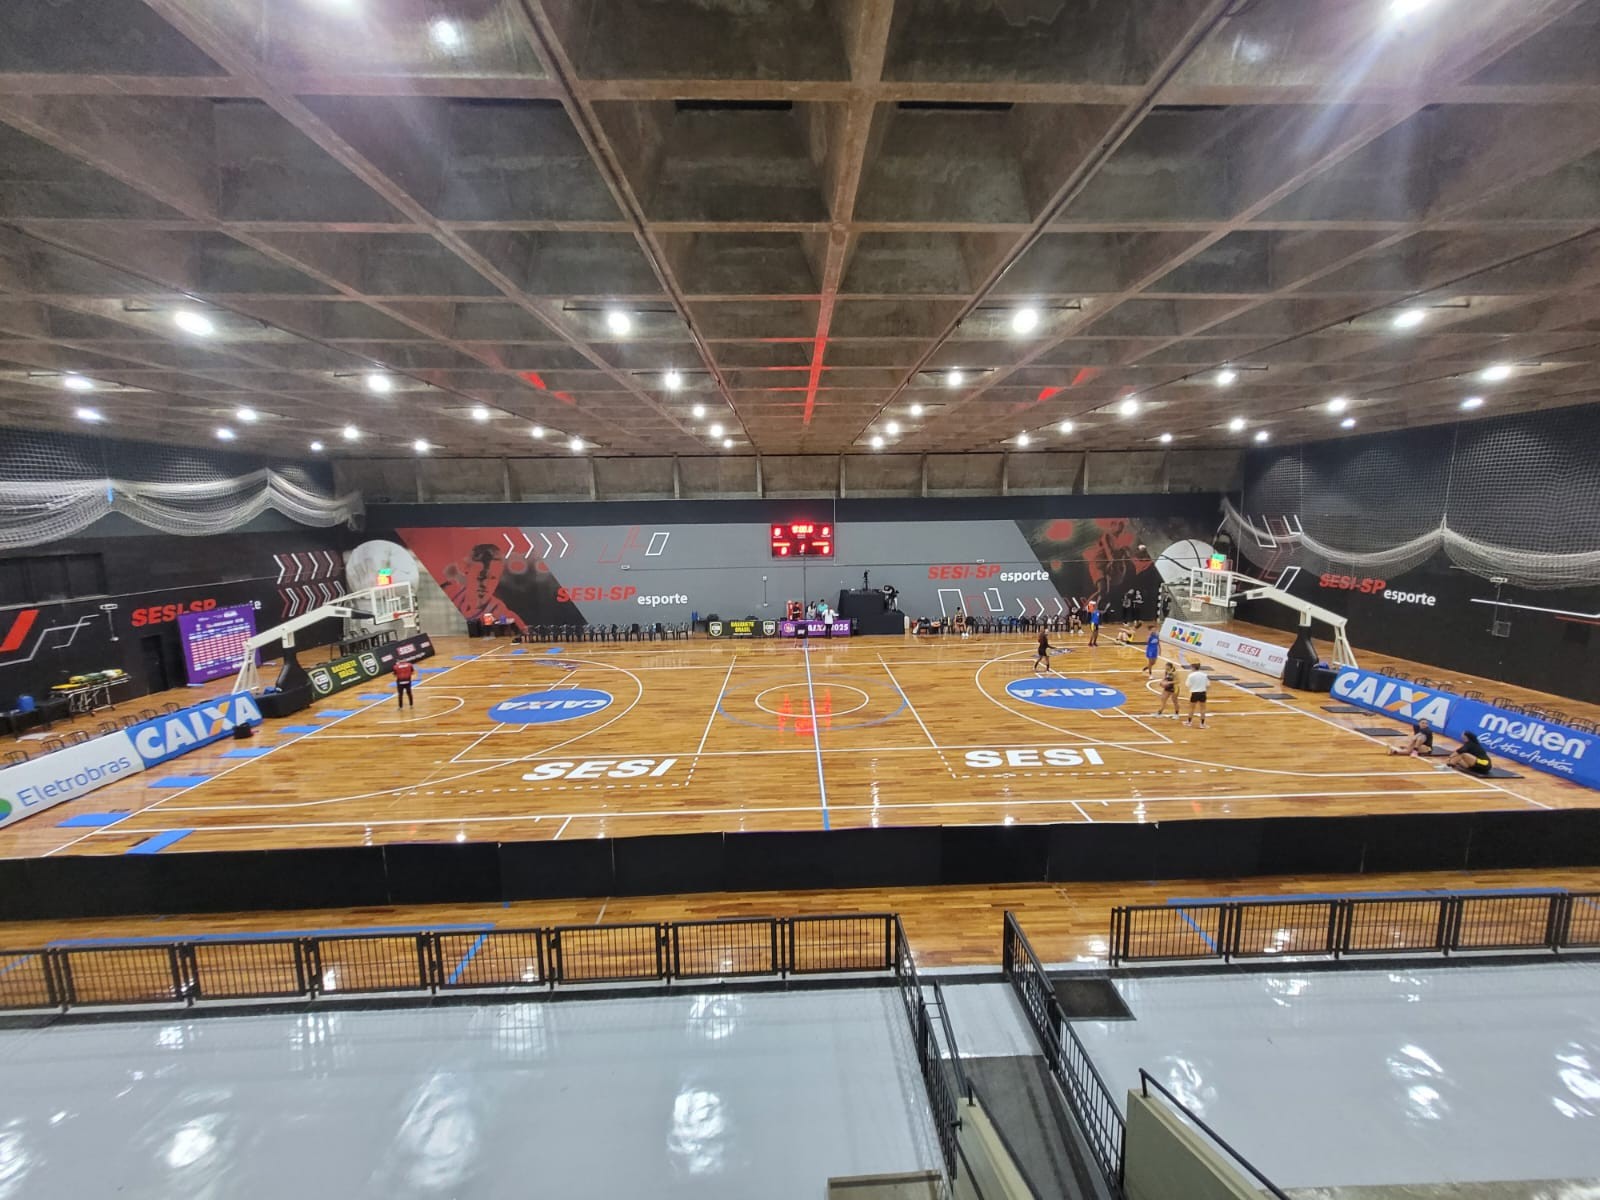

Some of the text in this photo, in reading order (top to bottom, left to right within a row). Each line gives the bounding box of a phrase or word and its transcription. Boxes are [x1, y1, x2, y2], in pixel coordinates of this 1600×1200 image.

[928, 564, 1049, 582] SESI-SP esporte
[556, 585, 688, 607] SESI-SP esporte
[1319, 572, 1436, 606] SESI-SP esporte
[1239, 645, 1261, 657] SESI
[1010, 687, 1117, 698] CAIXA
[1333, 671, 1450, 729] CAIXA
[497, 700, 609, 711] CAIXA
[135, 696, 262, 759] CAIXA
[1479, 713, 1586, 759] molten
[965, 748, 1105, 767] SESI
[521, 758, 678, 781] SESI
[16, 755, 131, 807] Eletrobras
